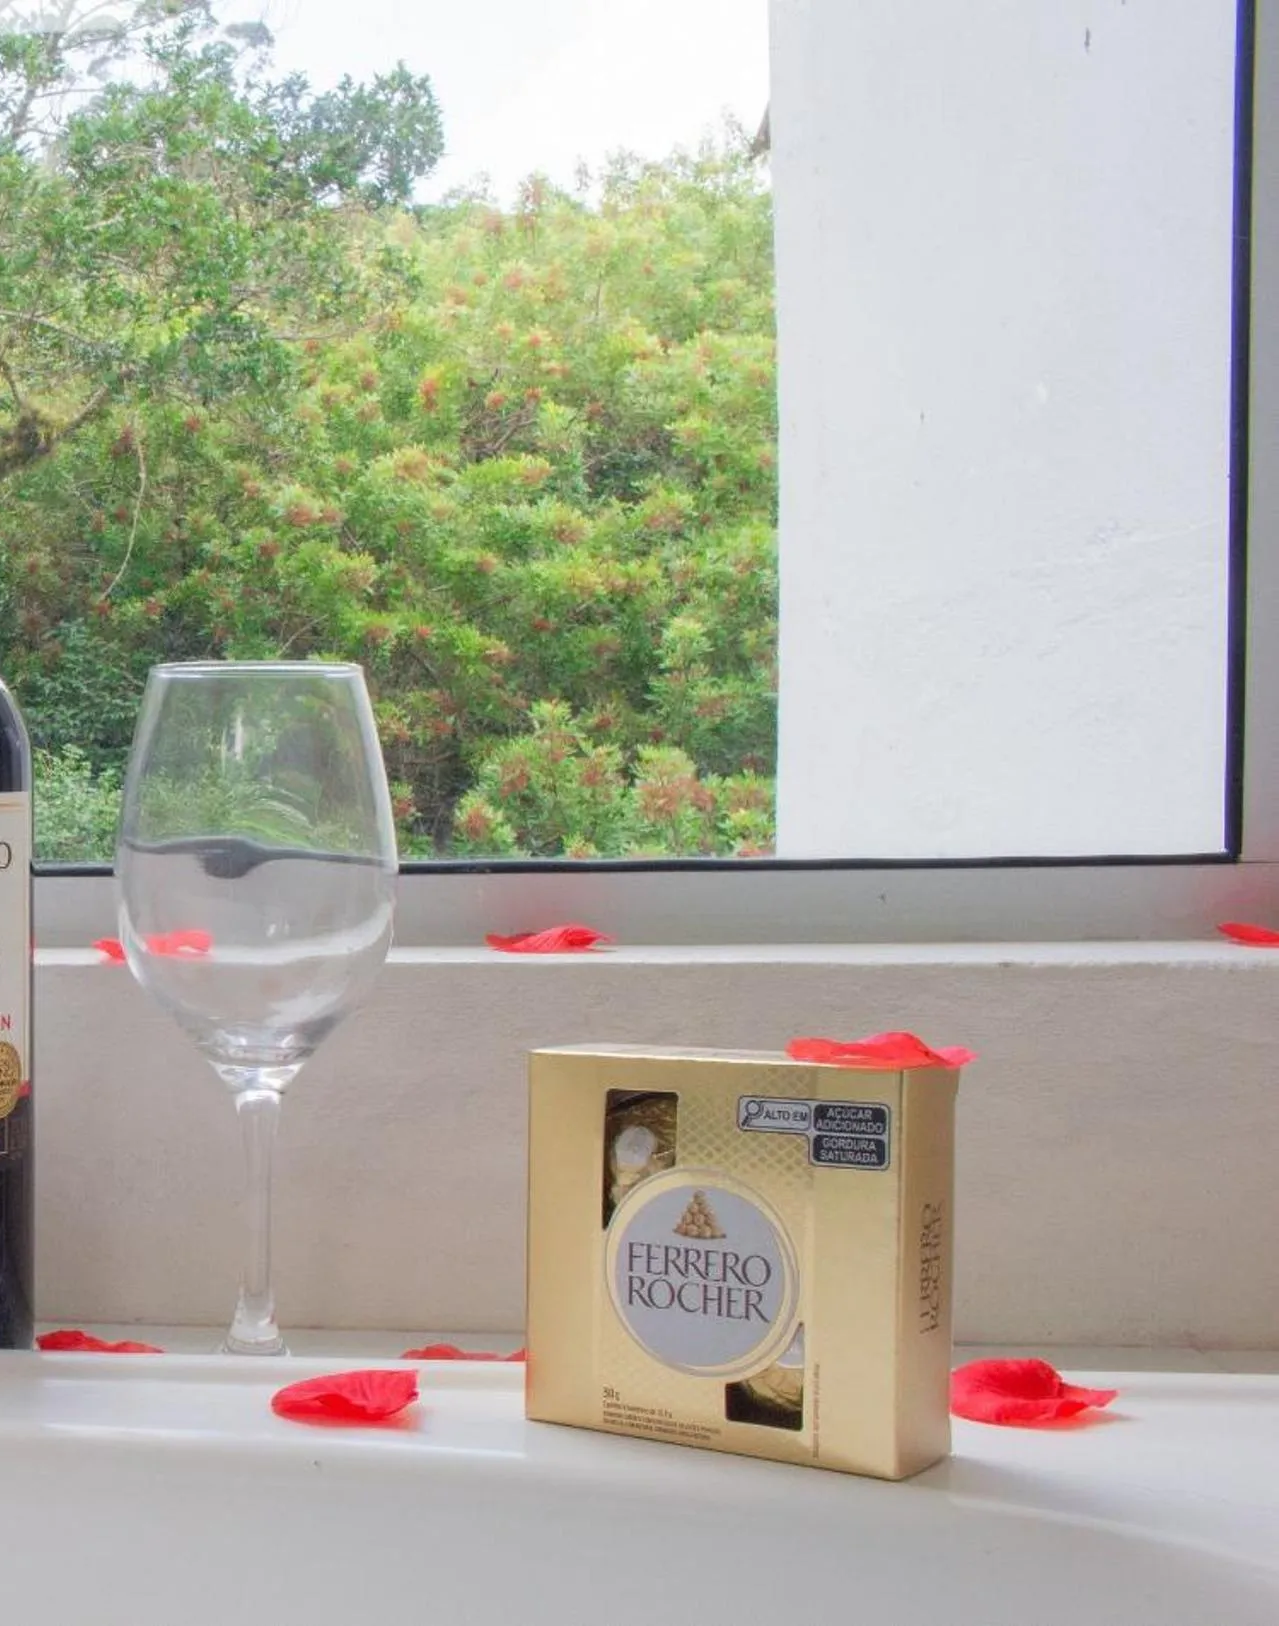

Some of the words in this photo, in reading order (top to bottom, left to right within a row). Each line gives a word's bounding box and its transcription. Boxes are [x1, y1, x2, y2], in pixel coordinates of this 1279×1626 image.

[764, 1109, 790, 1121] ALTO
[792, 1111, 808, 1122] EM
[816, 1120, 884, 1134] ADICIONADO
[822, 1137, 877, 1151] GORDURA
[820, 1149, 878, 1164] SATURADA
[628, 1241, 772, 1287] FERRERO
[628, 1275, 770, 1324] ROCHER
